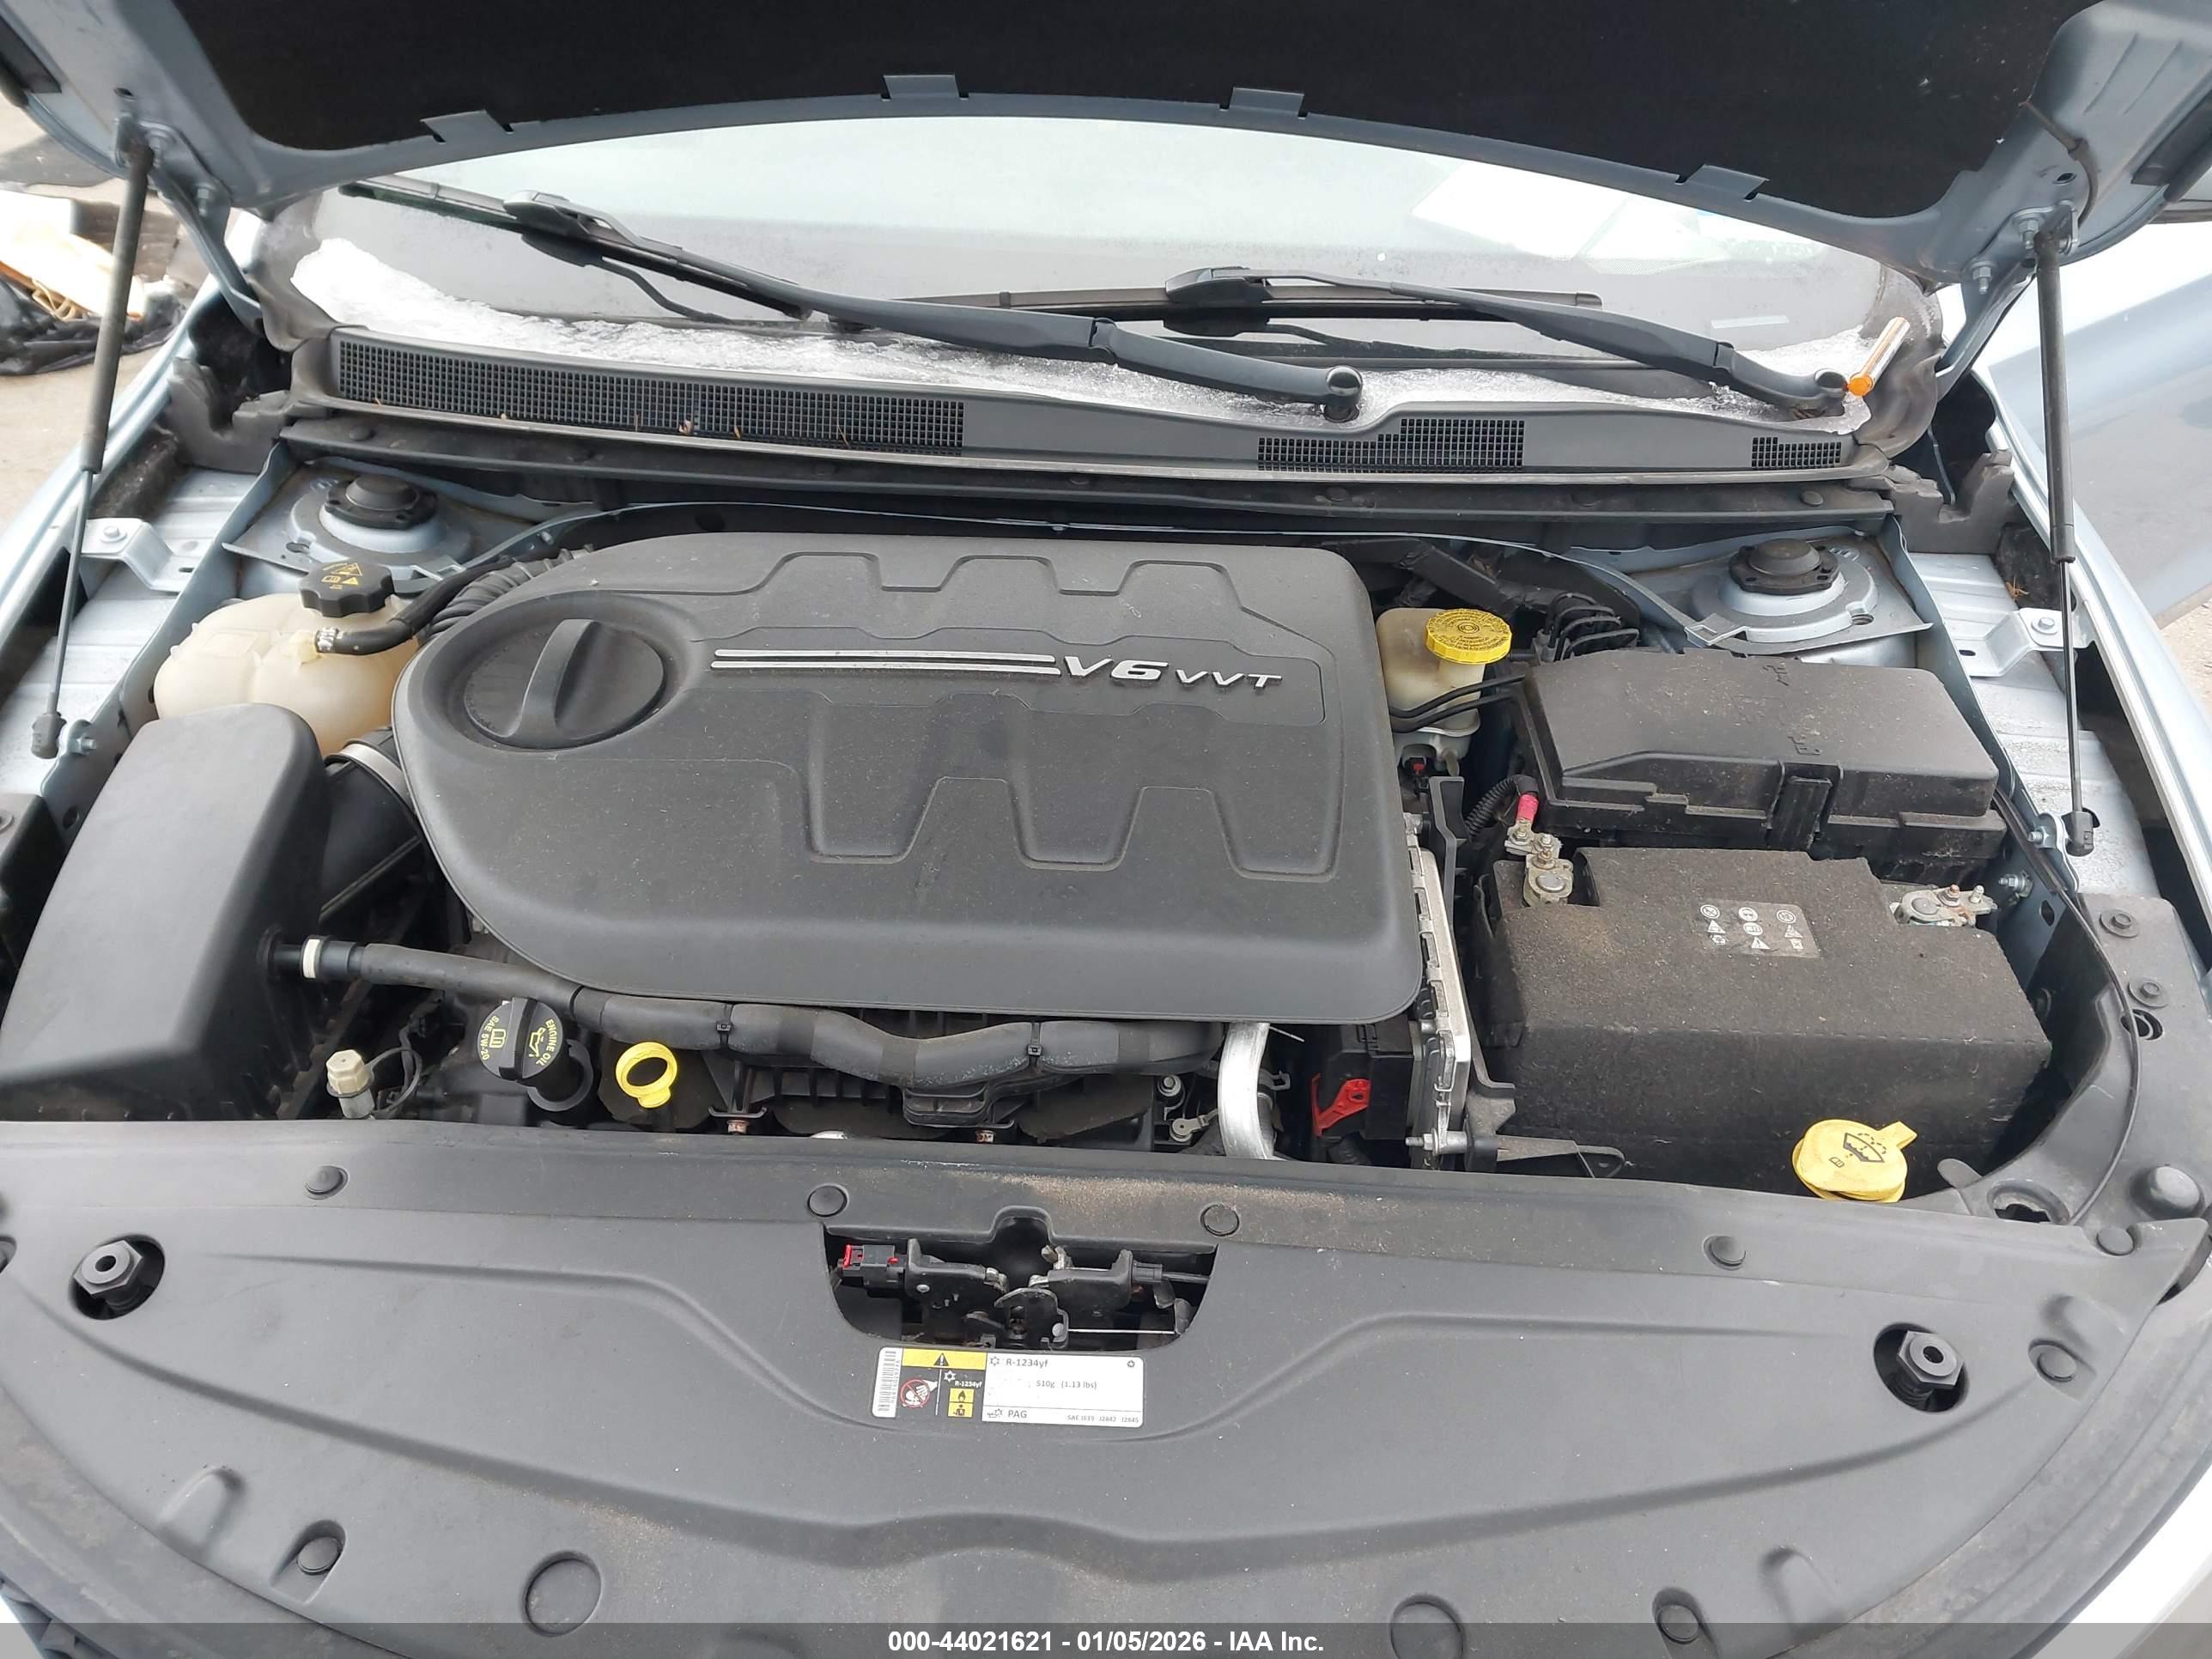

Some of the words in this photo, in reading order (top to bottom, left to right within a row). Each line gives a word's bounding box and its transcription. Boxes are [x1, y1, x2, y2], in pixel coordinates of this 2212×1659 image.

[1064, 655, 1170, 681] V6
[1175, 669, 1283, 689] VVT
[484, 1015, 500, 1032] SAE
[545, 1018, 557, 1052] ENGINE
[481, 1033, 490, 1060] 5W-20
[535, 1053, 551, 1066] OIL
[1006, 1358, 1048, 1369] R-1234yf
[954, 1380, 983, 1389] R-1234yf
[1036, 1380, 1055, 1389] 510g
[1082, 1381, 1097, 1390] lbs)
[1007, 1410, 1028, 1419] PAG
